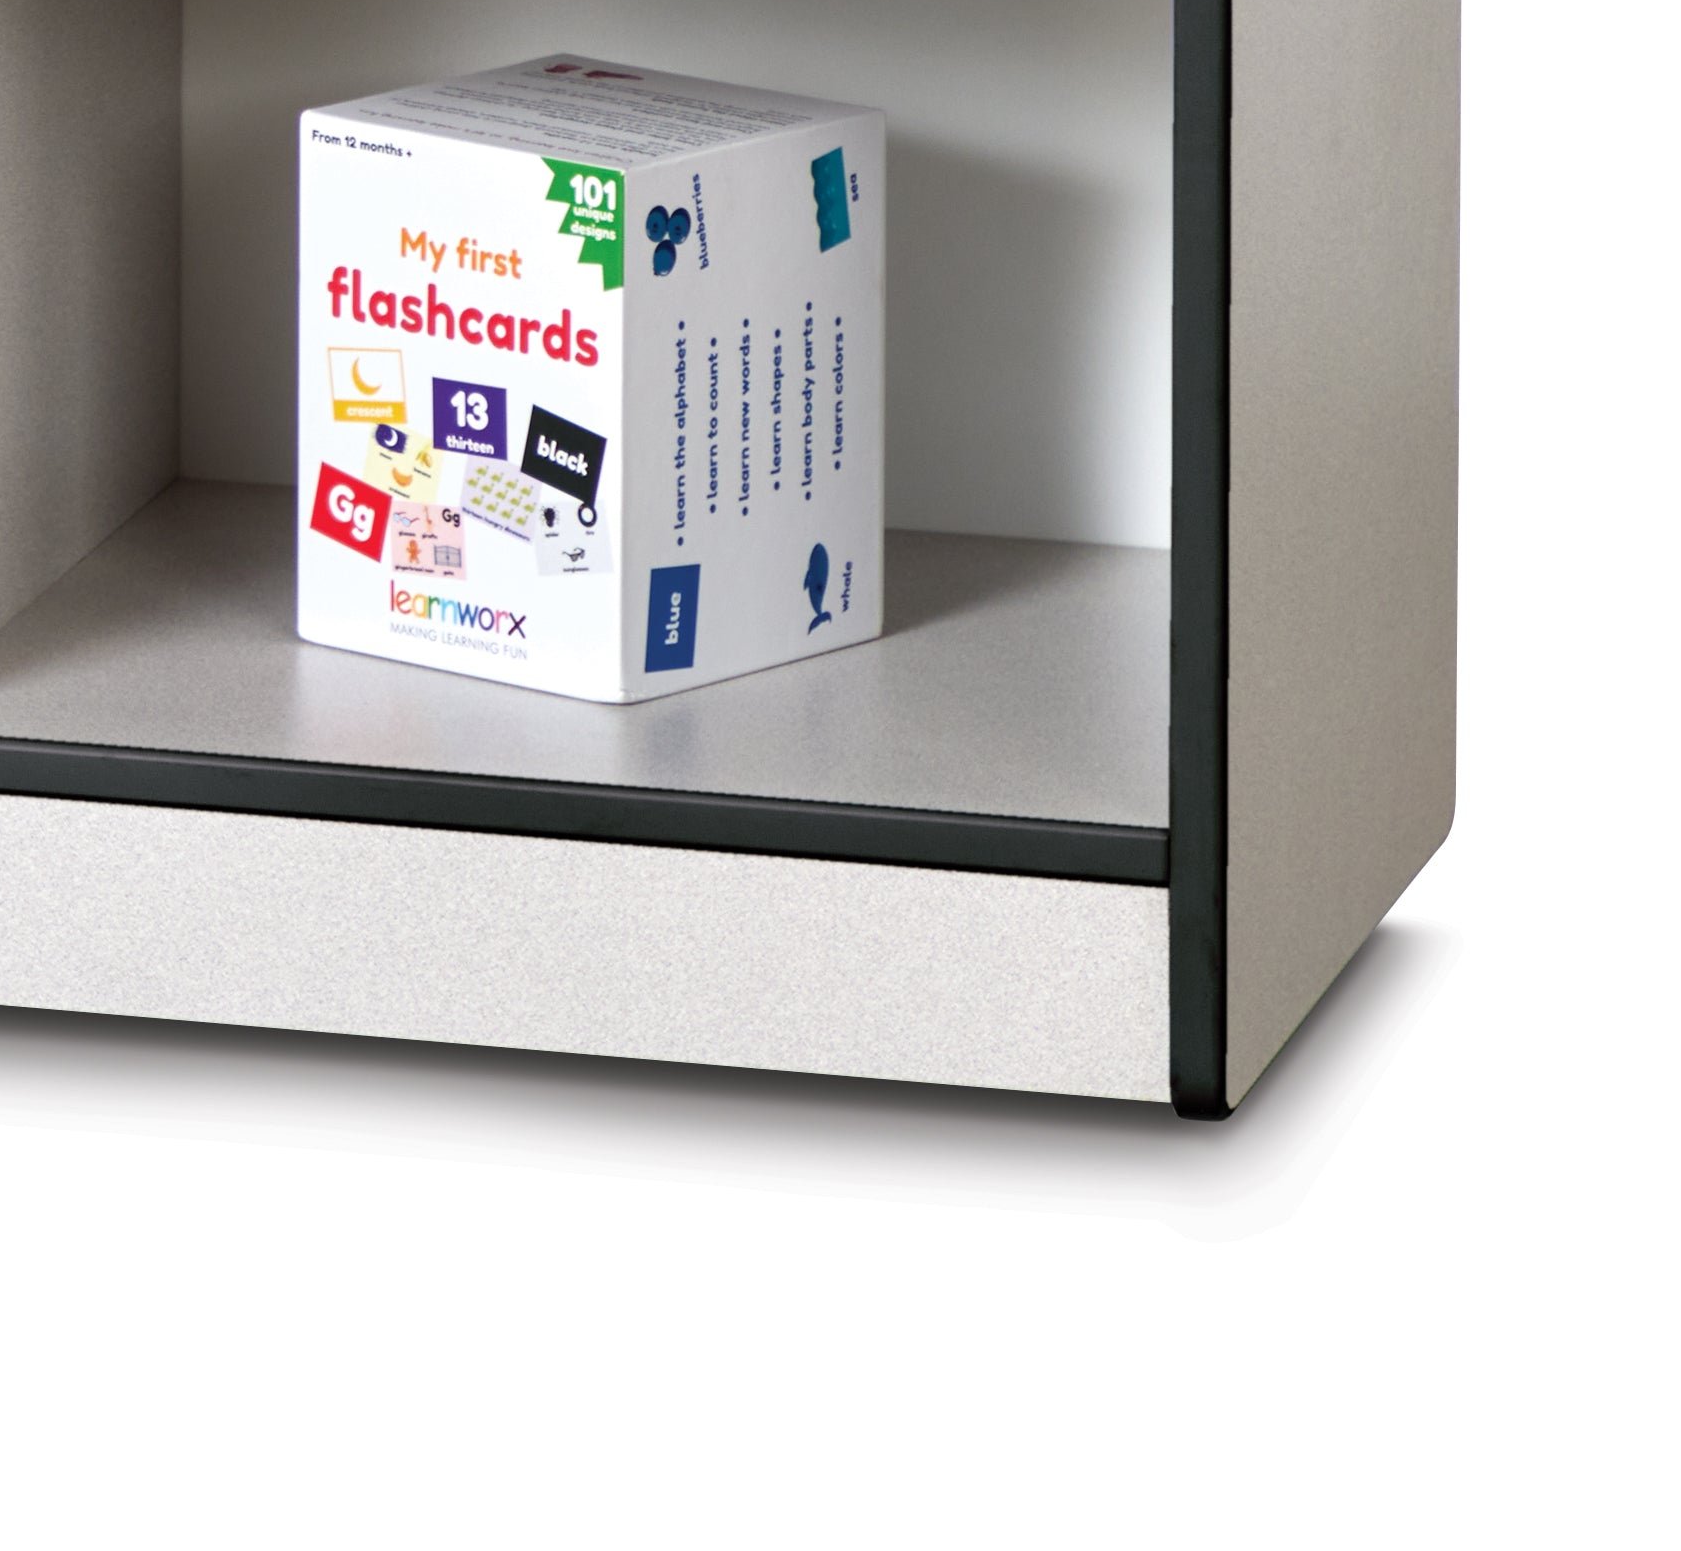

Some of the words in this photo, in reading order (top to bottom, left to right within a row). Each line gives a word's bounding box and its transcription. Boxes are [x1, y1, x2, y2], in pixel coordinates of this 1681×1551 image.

[311, 129, 341, 146] From
[345, 135, 356, 149] 12
[359, 139, 404, 158] months
[405, 149, 413, 158] +
[569, 173, 617, 211] 101
[572, 204, 615, 224] unique
[850, 172, 860, 203] sea
[570, 221, 617, 242] designs
[691, 173, 710, 271] blueberries
[400, 226, 447, 273] My
[456, 237, 523, 280] first
[327, 265, 599, 368] flashcards
[739, 334, 751, 396] words
[803, 316, 815, 372] parts
[832, 332, 844, 395] colors
[674, 338, 689, 430] alphabet
[707, 352, 719, 412] count
[770, 344, 785, 415] shapes
[801, 376, 816, 428] body
[346, 404, 395, 419] crescent
[450, 390, 490, 431] 13
[707, 416, 719, 440] to
[741, 400, 751, 443] new
[832, 400, 844, 456] learn
[445, 434, 496, 456] thirteen
[536, 434, 590, 477] black
[674, 434, 686, 470] the
[706, 443, 719, 500] learn
[770, 420, 782, 475] learn
[801, 431, 813, 487] learn
[738, 446, 751, 502] learn
[328, 483, 376, 542] Gg
[441, 507, 461, 528] Gg
[674, 474, 686, 530] learn
[390, 579, 527, 639] learnworx
[841, 560, 854, 613] whale
[390, 622, 438, 642] MAKING
[441, 625, 500, 655] LEARNING
[503, 643, 528, 660] FUN
[664, 591, 683, 646] blue
